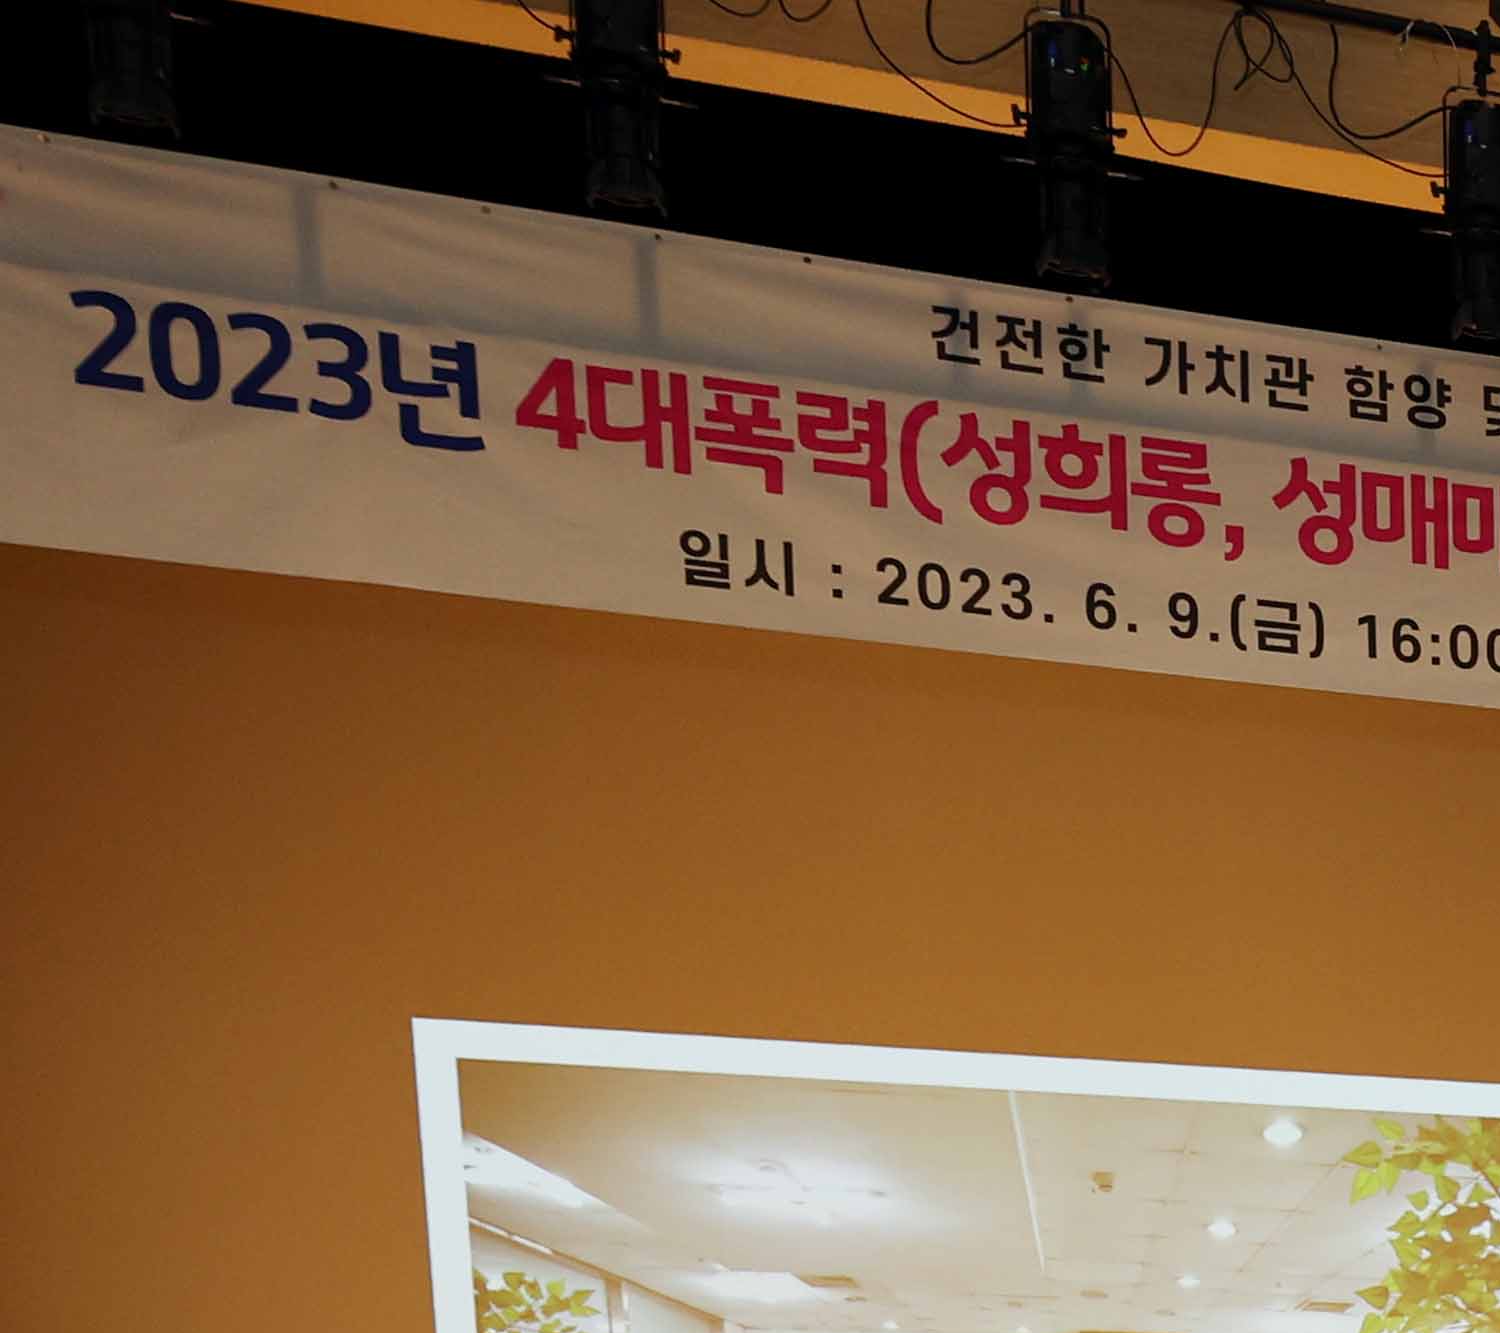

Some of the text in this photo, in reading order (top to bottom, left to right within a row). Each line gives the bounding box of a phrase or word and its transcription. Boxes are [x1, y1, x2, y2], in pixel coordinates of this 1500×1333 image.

[71, 290, 487, 451] 2023년
[515, 357, 1246, 562] 4대폭력(성희롱,
[930, 304, 1112, 382] 건전한
[1142, 336, 1315, 411] 가치관
[1345, 365, 1451, 429] 함양
[680, 530, 794, 596] 일시
[832, 565, 842, 598] :
[877, 558, 1053, 623] 2023.
[1086, 583, 1136, 632] 6.
[1169, 593, 1324, 658] 9.(금)
